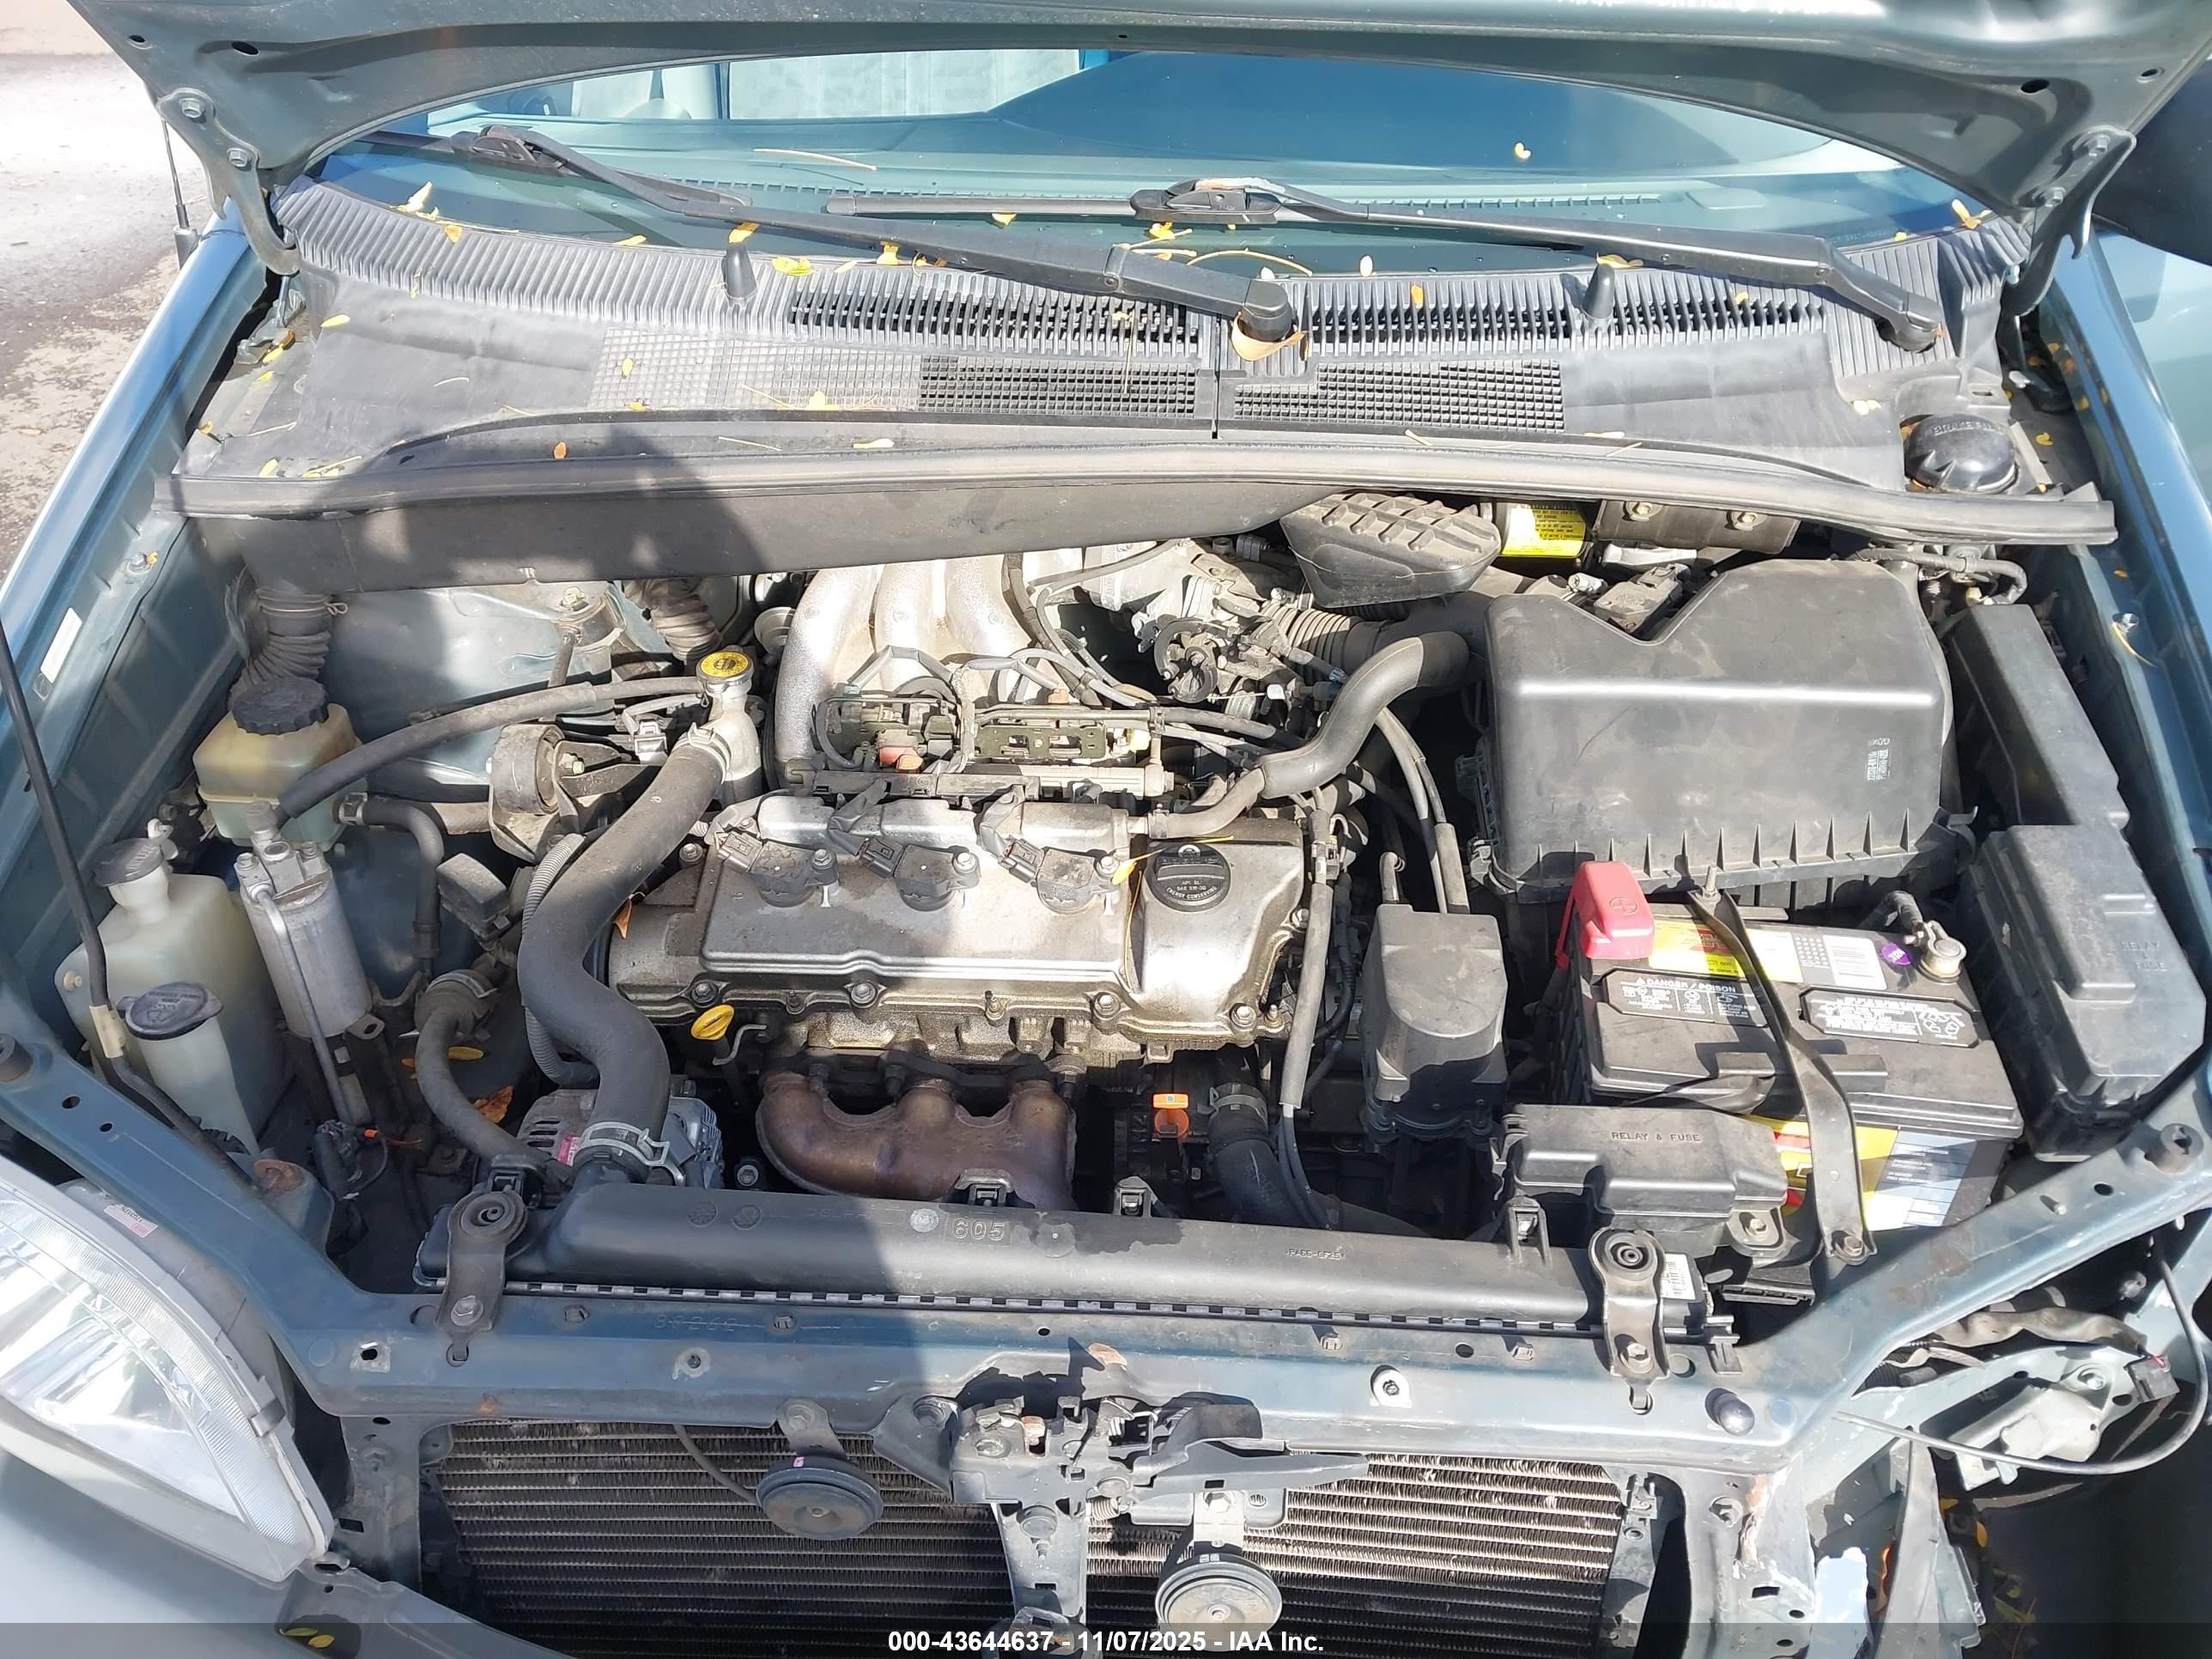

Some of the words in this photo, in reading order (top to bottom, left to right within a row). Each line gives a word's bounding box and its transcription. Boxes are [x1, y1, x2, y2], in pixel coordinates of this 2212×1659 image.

[1186, 885, 1218, 899] CONSERVING
[1646, 977, 1688, 989] DANGER
[1698, 982, 1736, 994] POISON
[1611, 1131, 1650, 1141] RELAY
[1656, 1133, 1663, 1141] &
[1670, 1133, 1703, 1143] FUSE
[951, 1217, 1006, 1242] 605
